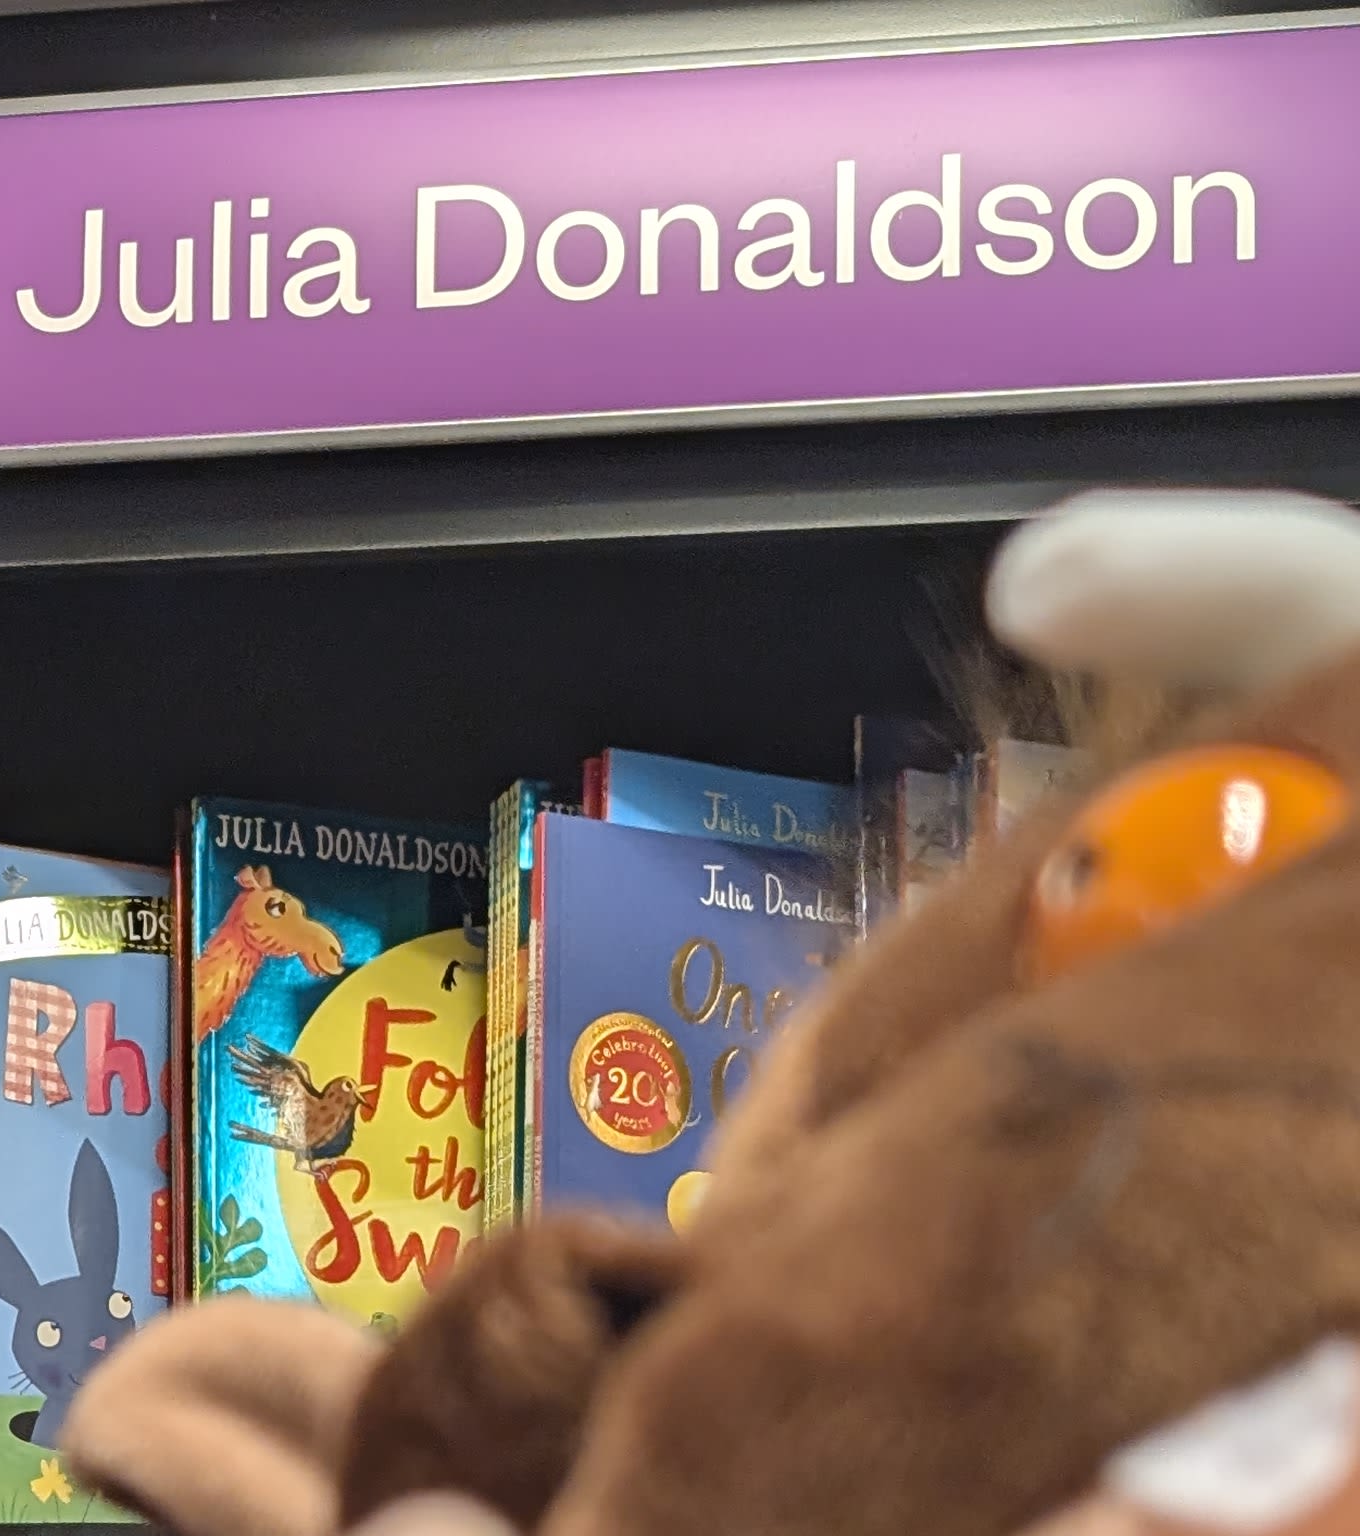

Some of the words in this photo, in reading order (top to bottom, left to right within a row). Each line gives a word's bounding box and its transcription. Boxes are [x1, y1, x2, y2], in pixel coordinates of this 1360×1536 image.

[15, 194, 371, 334] Julia
[414, 152, 1259, 310] Donaldson
[215, 813, 307, 859] JULIA
[704, 790, 762, 839] Julia
[699, 864, 755, 912] Julia
[3, 977, 172, 1117] Rh
[607, 1066, 660, 1107] 20
[612, 1110, 653, 1131] years
[305, 1158, 486, 1293] Sw
